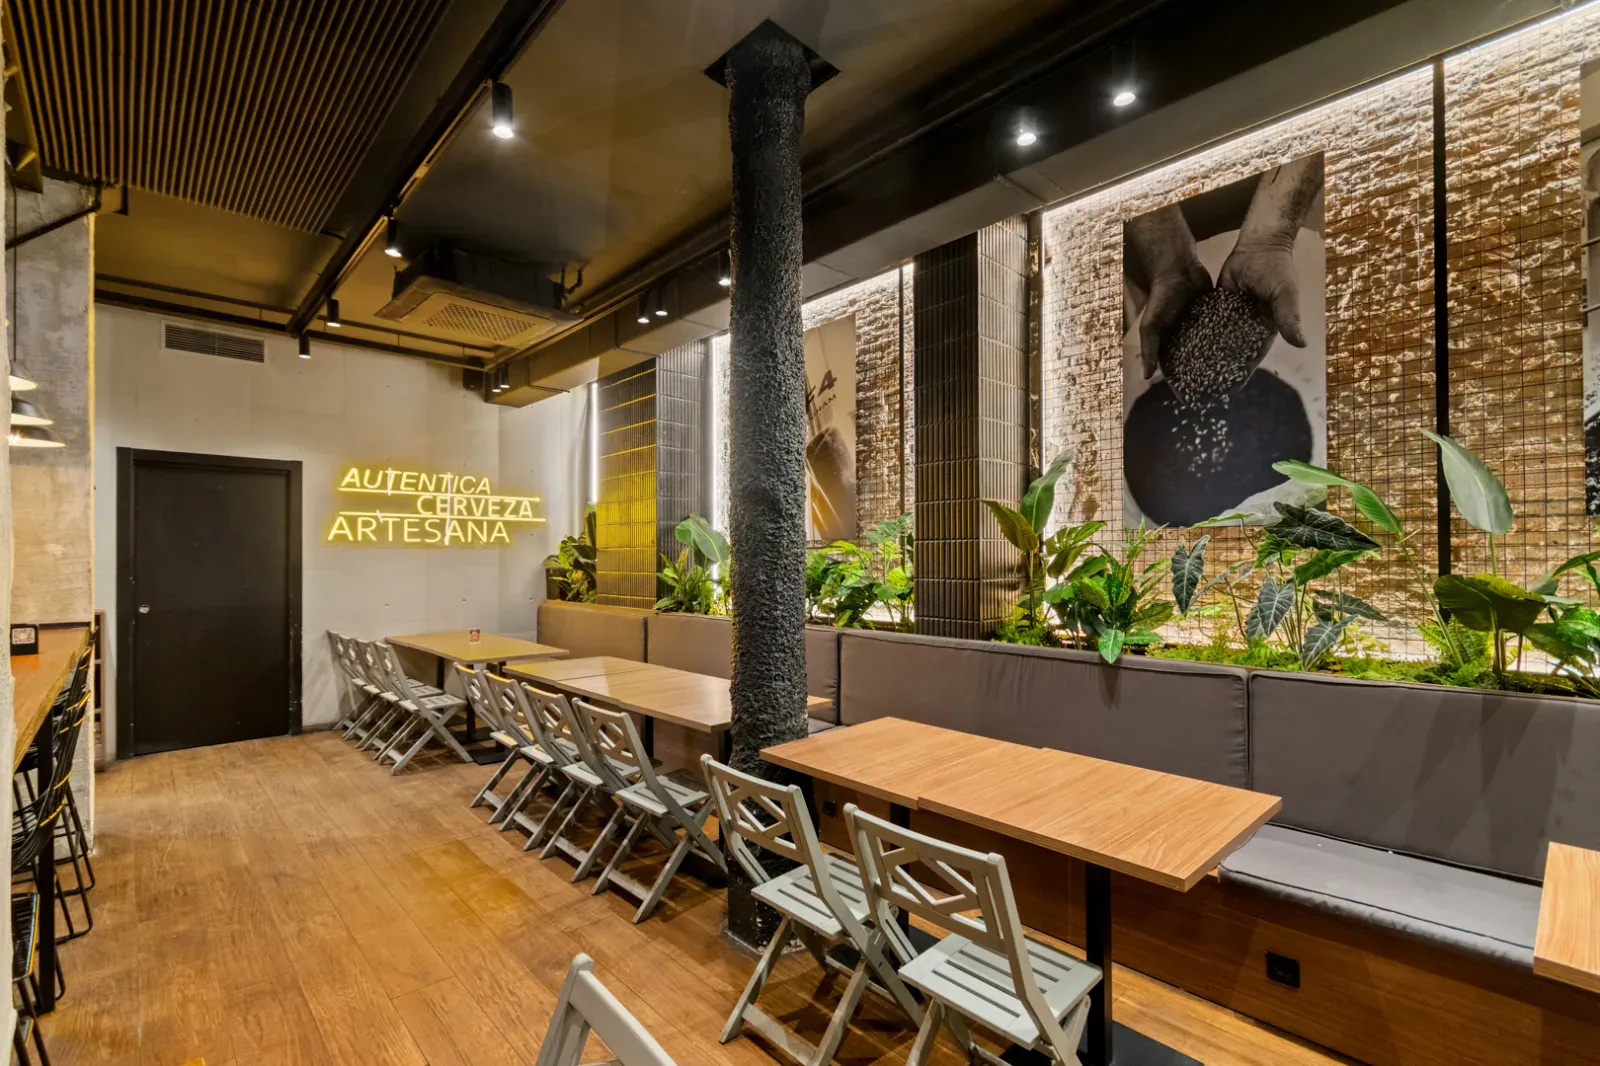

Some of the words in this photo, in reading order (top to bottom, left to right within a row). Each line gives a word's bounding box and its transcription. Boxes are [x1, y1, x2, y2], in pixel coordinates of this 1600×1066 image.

[340, 467, 491, 495] AUTENTICA
[417, 495, 534, 519] CERVEZA
[327, 516, 511, 544] ARTESANA
